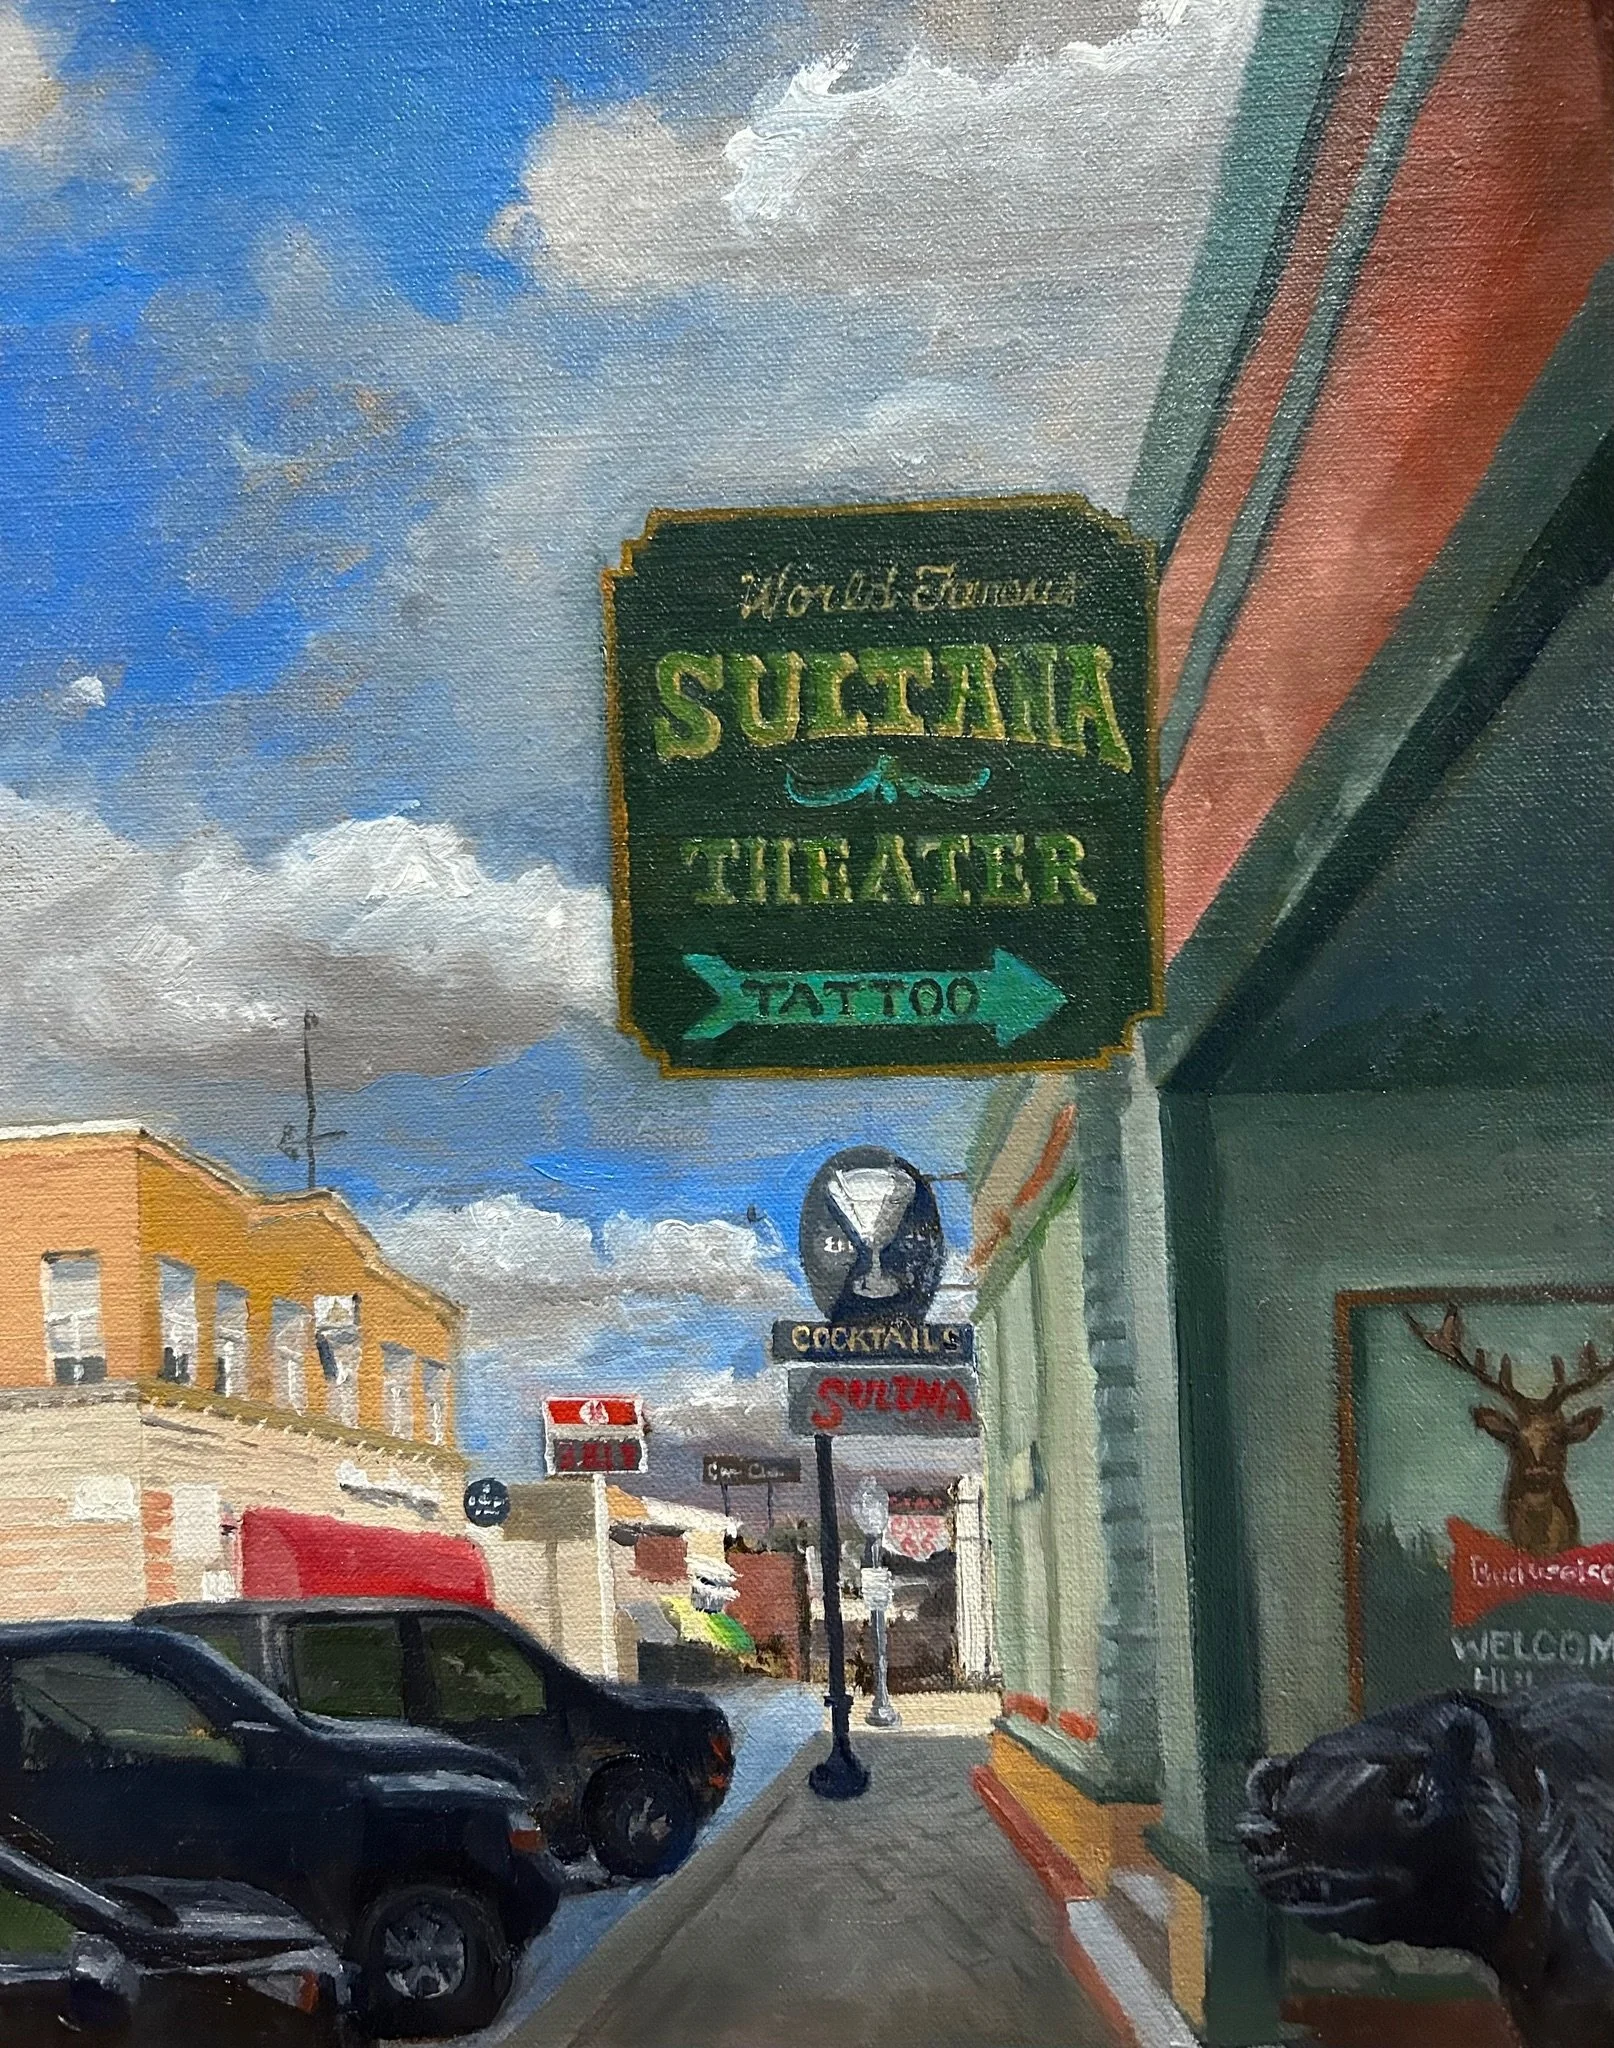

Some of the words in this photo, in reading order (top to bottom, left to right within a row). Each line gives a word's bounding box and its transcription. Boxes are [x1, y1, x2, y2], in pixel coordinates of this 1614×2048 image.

[653, 643, 1133, 774] SULTANA
[681, 832, 1097, 906] THEATER
[740, 976, 981, 1017] TATTOO
[790, 1324, 961, 1354] COCKTAILS
[1451, 1629, 1614, 1669] WELCOM
